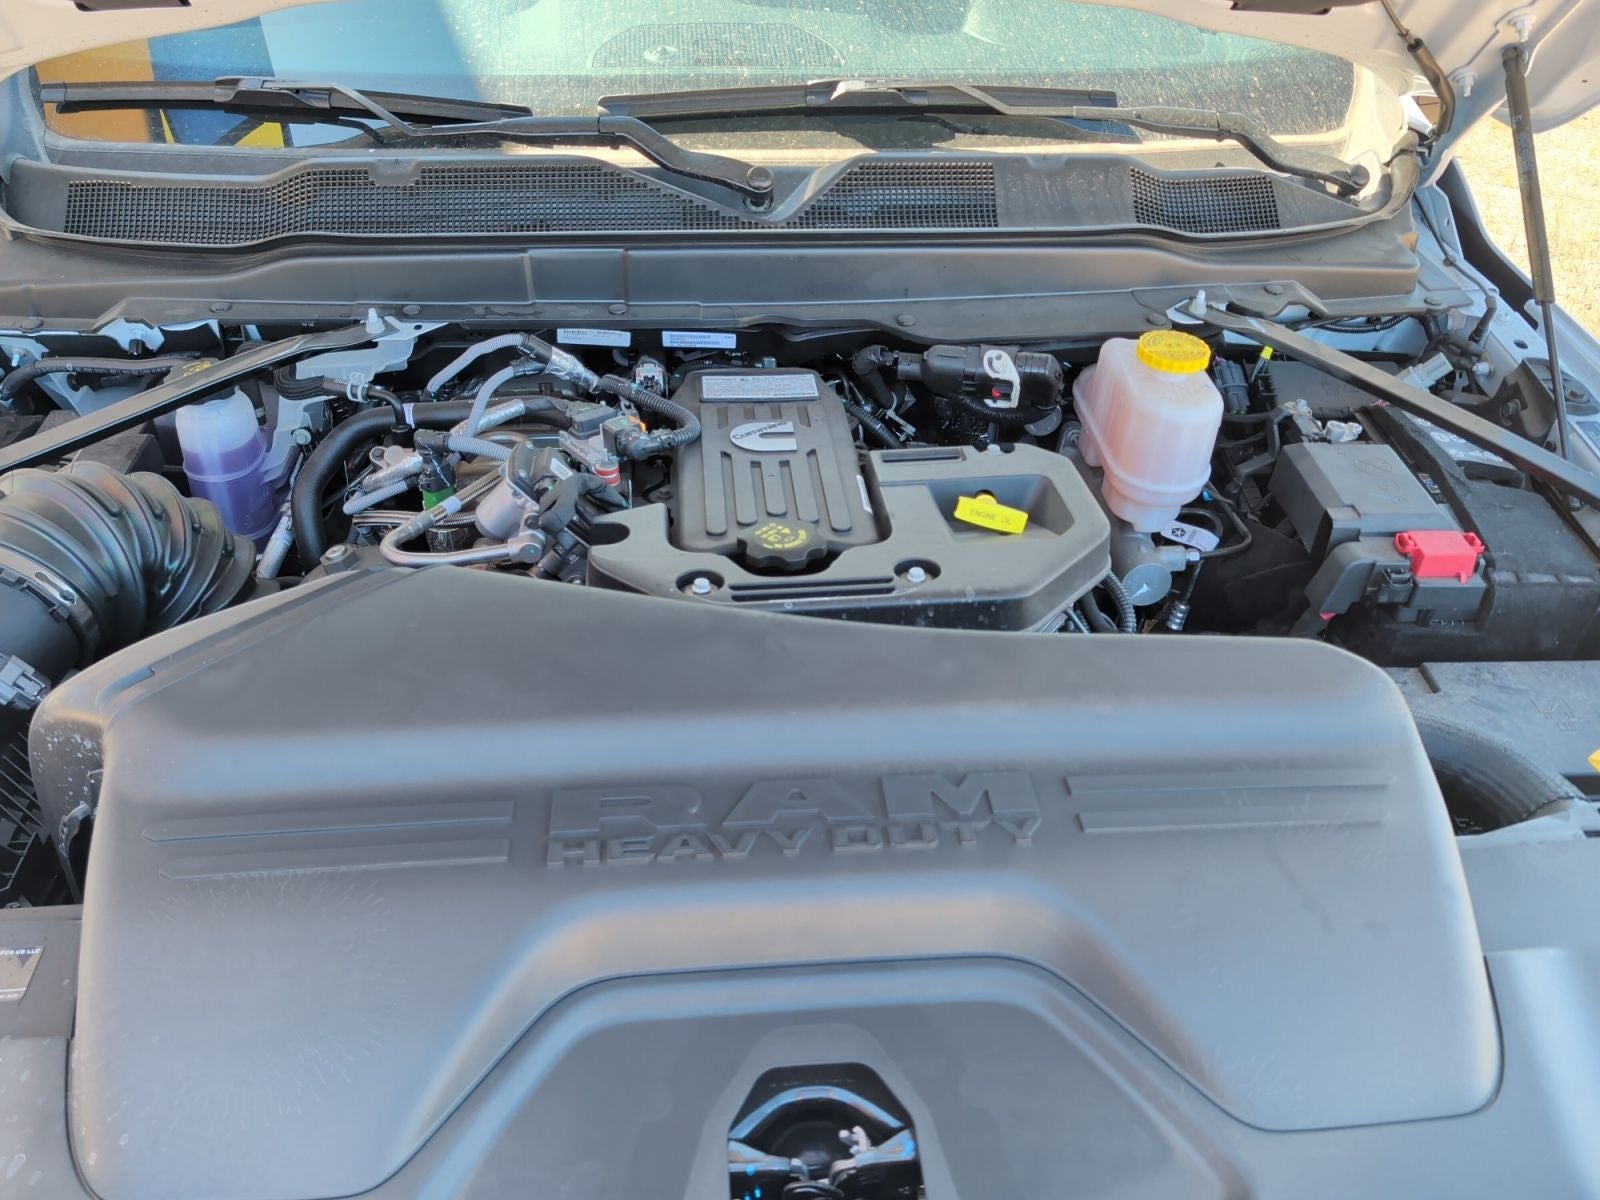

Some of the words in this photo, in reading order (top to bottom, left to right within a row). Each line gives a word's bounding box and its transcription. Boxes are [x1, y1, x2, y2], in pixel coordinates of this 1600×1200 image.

[970, 508, 996, 521] ENGINE
[548, 769, 1041, 834] RAM
[546, 827, 814, 865] HEAVY
[831, 817, 1043, 851] DUTY
